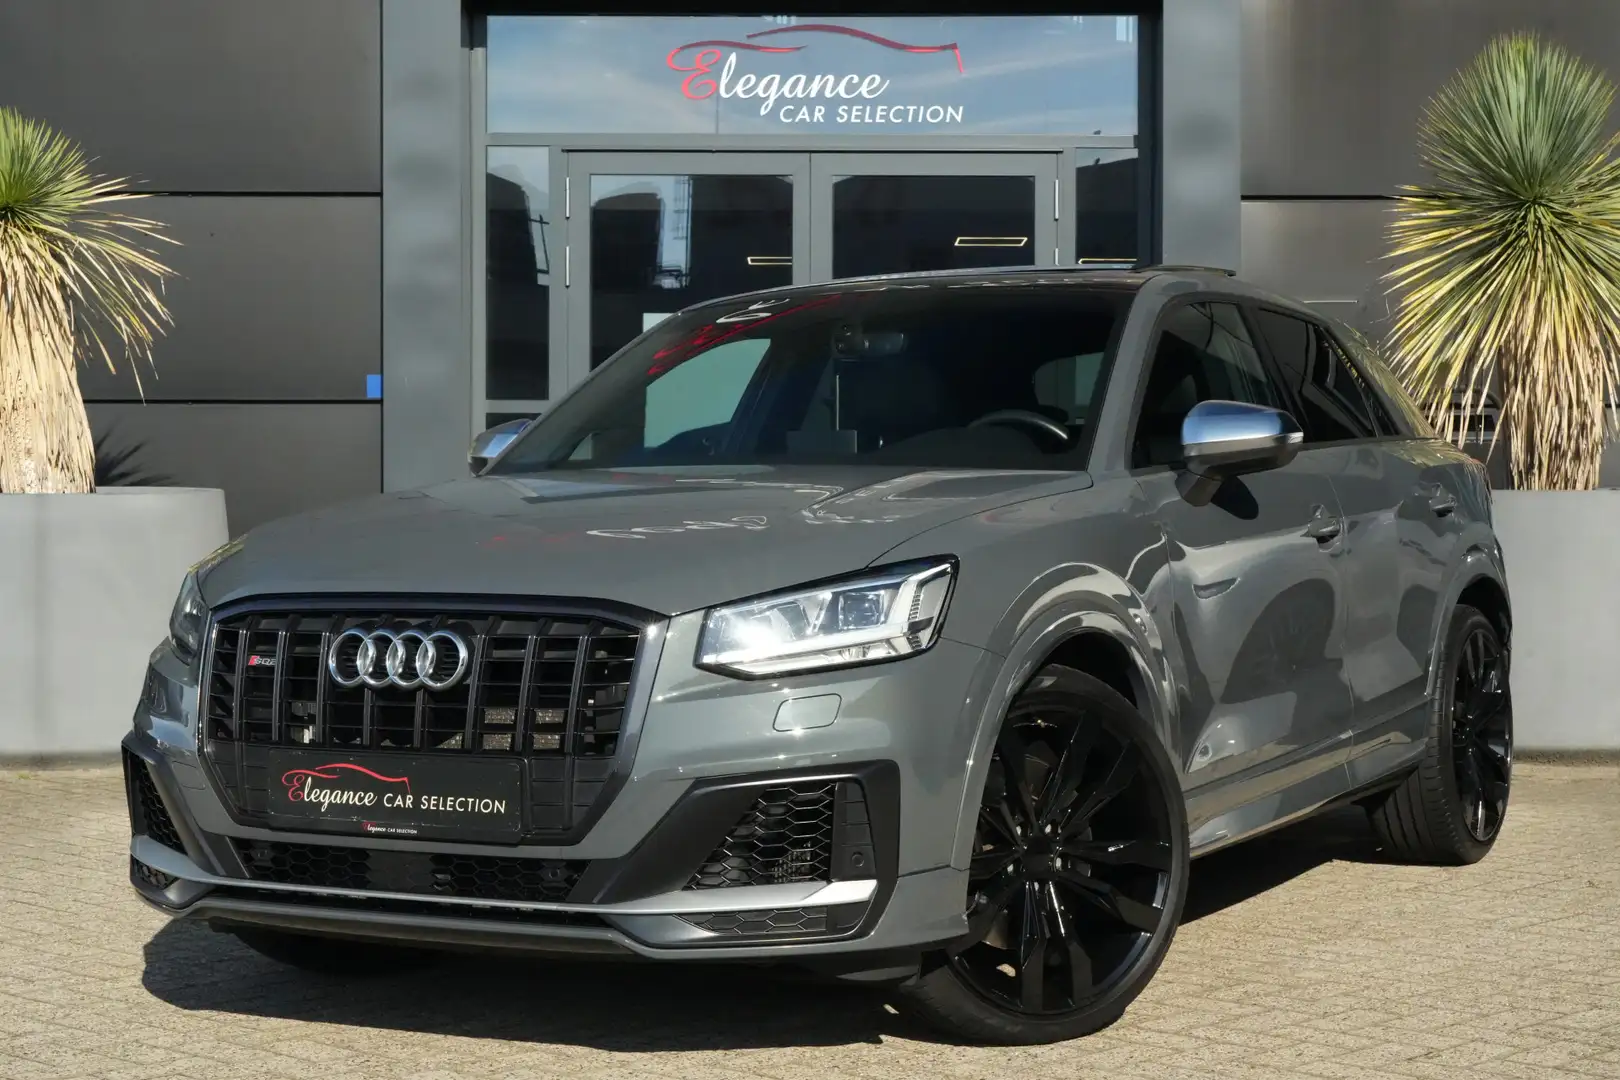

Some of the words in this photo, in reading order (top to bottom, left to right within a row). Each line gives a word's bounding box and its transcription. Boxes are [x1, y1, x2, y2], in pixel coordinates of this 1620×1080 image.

[667, 48, 890, 116] Elegance
[779, 105, 825, 123] CAR
[836, 105, 964, 123] SELECTION
[281, 774, 378, 812] Elegance
[383, 793, 414, 809] CAR
[420, 796, 506, 814] SELECTION
